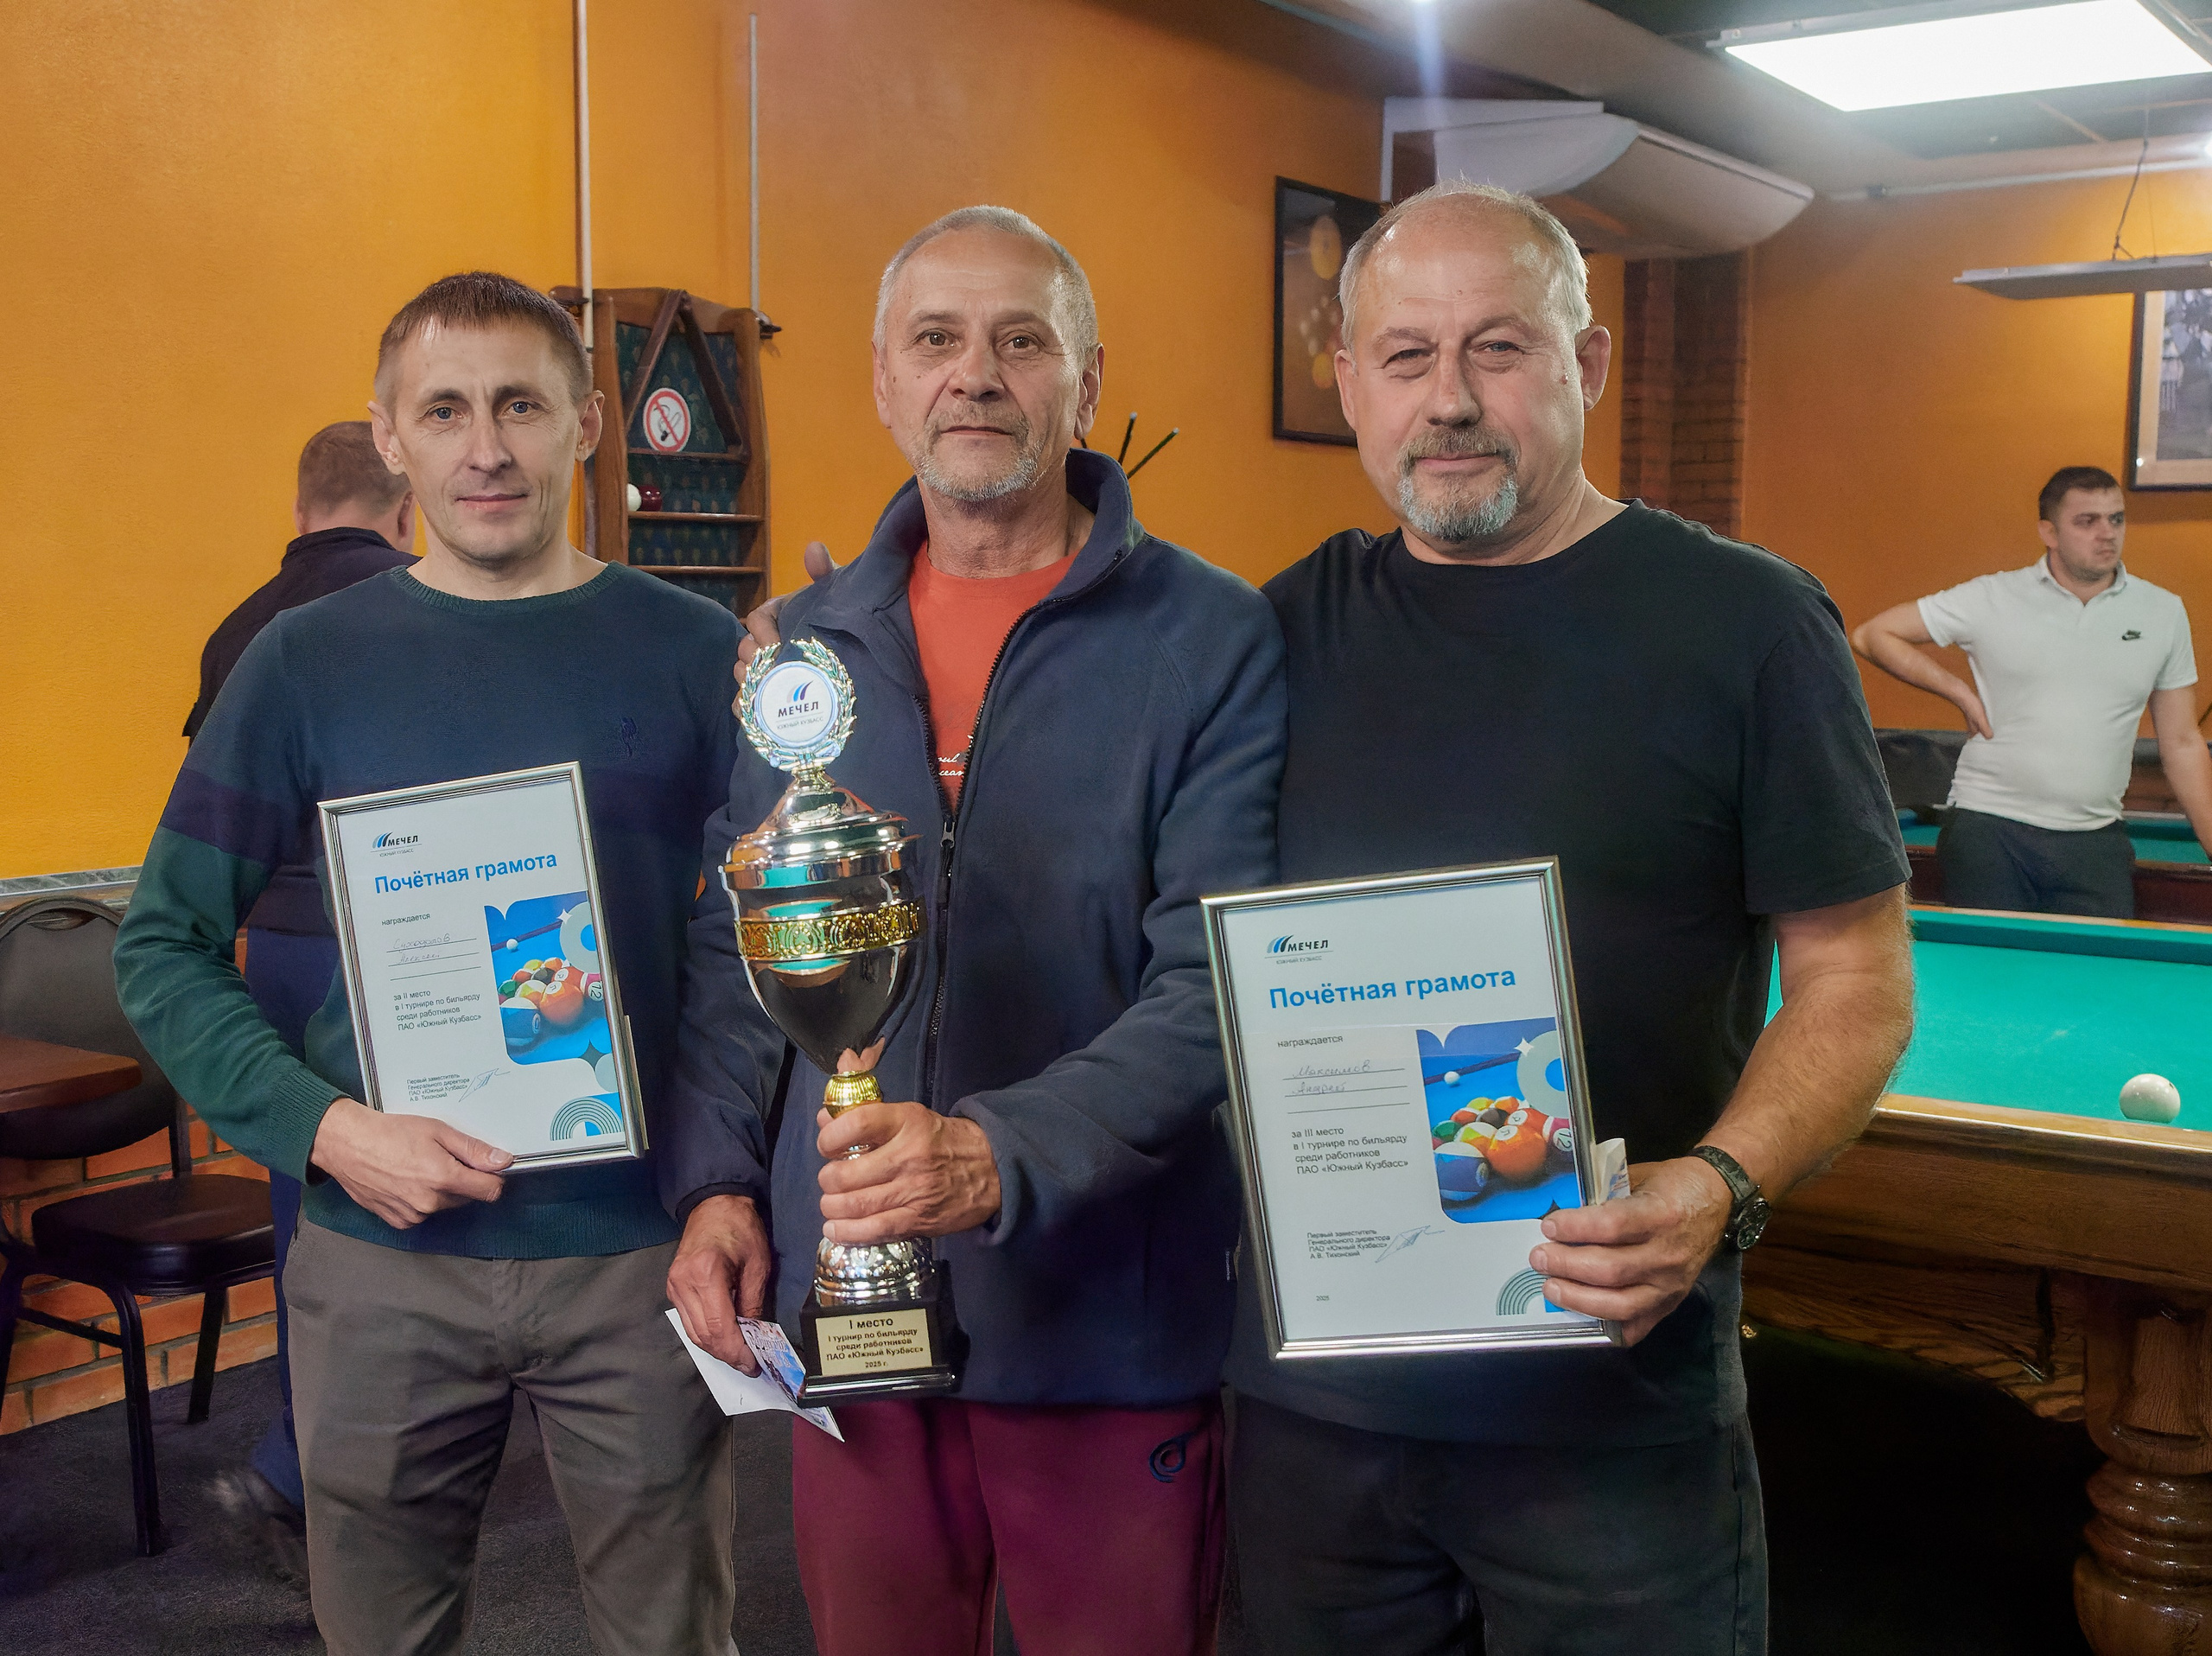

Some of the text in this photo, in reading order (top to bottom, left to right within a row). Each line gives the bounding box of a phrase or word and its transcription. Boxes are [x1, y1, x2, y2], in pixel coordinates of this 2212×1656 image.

[778, 701, 819, 717] МЕЧЕЛ
[387, 835, 418, 847] МЕЧЕЛ
[374, 854, 557, 894] Почётная грамота
[381, 913, 431, 927] награждается
[1287, 939, 1329, 952] МЕЧЕЛ
[410, 990, 431, 998] место
[1269, 970, 1516, 1009] Почётная грамота
[405, 1000, 435, 1011] турнире
[446, 993, 480, 1003] бильярду
[397, 1007, 461, 1022] среди работников
[397, 1014, 481, 1031] ПАО «Южный Кузбасс»
[1277, 1035, 1344, 1048] награждается
[407, 1073, 461, 1085] Первый заместитель
[408, 1078, 470, 1091] Генерального директора
[1304, 1128, 1313, 1137] III
[1316, 1127, 1344, 1136] место
[1307, 1139, 1345, 1150] турнире
[1362, 1135, 1408, 1145] бильярду
[1295, 1150, 1381, 1163] среди работников
[1297, 1159, 1408, 1175] ПАО «Южный Кузбасс»
[1335, 1228, 1376, 1237] заместитель
[1307, 1234, 1390, 1245] Генерального директора
[849, 1318, 893, 1329] I место
[833, 1333, 862, 1343] турнир
[876, 1328, 918, 1338] бильярду
[836, 1339, 912, 1352] среди работников
[826, 1347, 924, 1361] ПАО «Южный Кузбасс»
